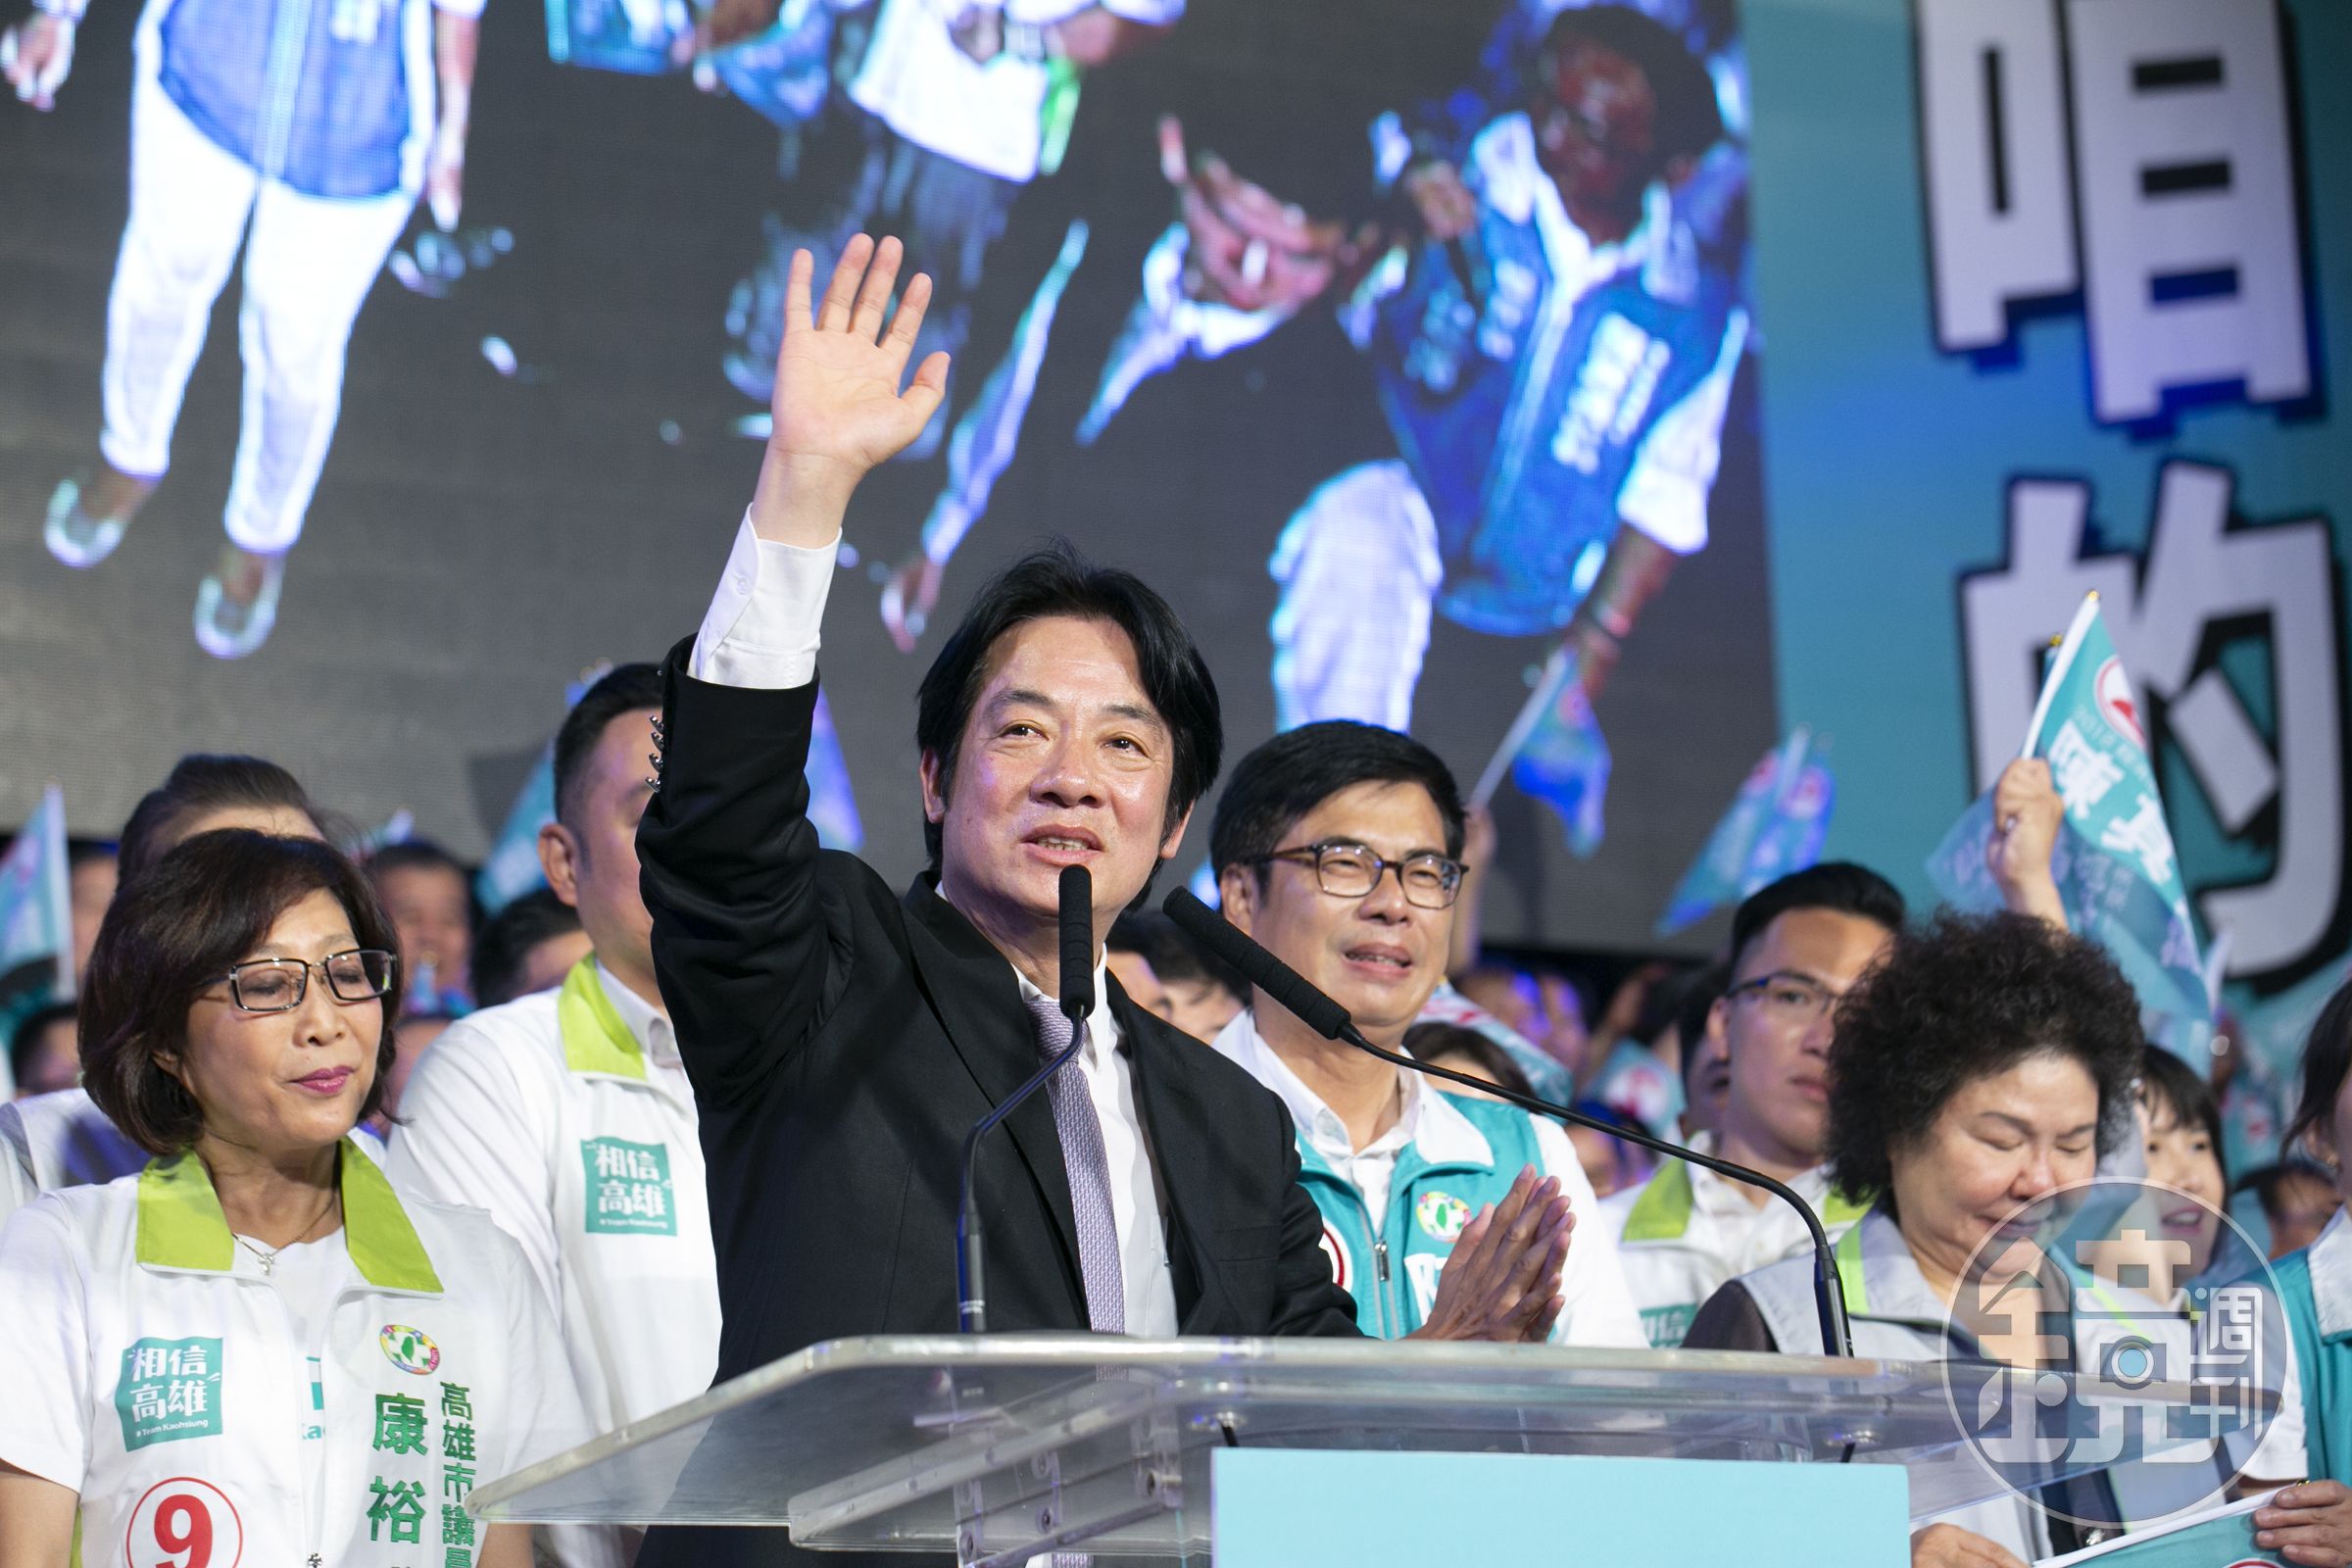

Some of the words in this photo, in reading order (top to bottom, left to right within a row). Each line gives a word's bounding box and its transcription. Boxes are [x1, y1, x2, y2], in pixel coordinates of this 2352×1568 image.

[596, 1144, 661, 1182] 相信
[597, 1179, 666, 1217] 高雄
[128, 1345, 208, 1383] 相信
[129, 1379, 208, 1423] 高雄
[366, 1392, 428, 1544] 康裕
[154, 1494, 213, 1568] 9
